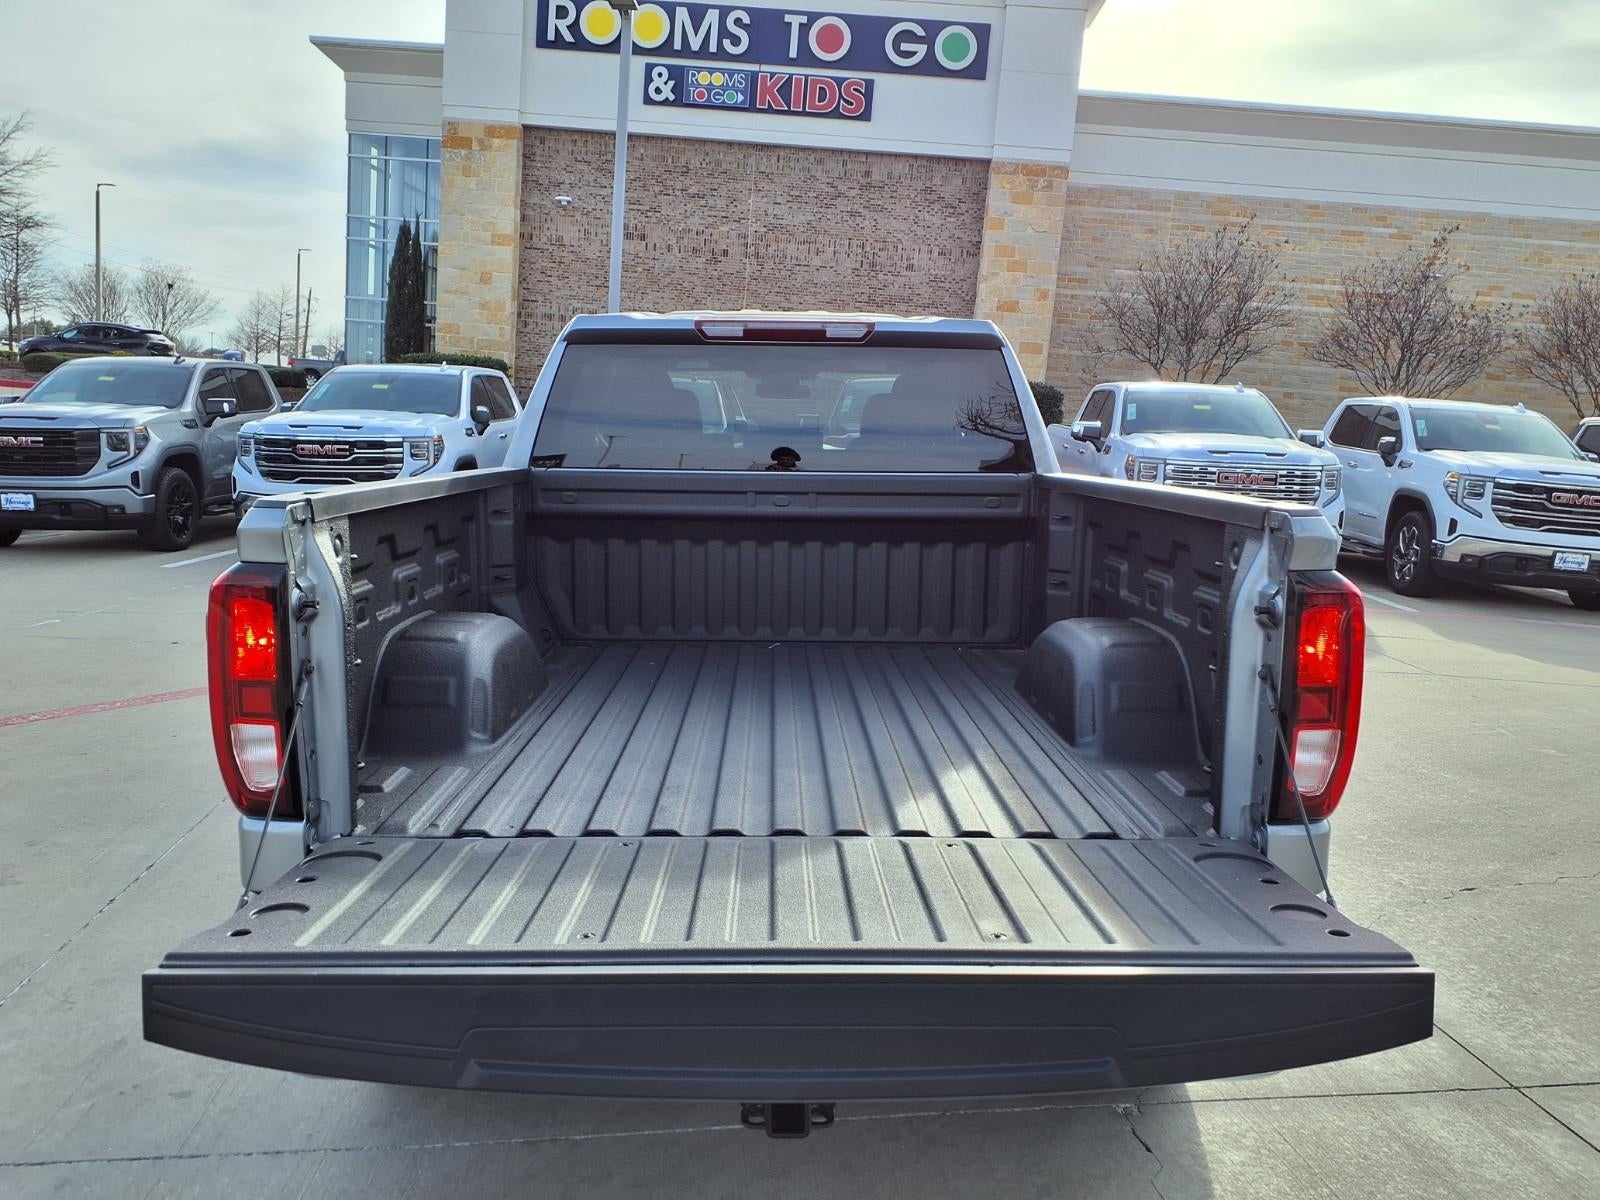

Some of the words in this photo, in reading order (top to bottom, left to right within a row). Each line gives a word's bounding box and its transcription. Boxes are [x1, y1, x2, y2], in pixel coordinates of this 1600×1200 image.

[547, 0, 750, 55] ROOMS
[784, 14, 852, 62] TO
[885, 21, 978, 70] GO
[648, 65, 676, 102] &
[688, 70, 746, 88] ROOMS
[688, 87, 708, 102] TO
[710, 89, 737, 104] GO
[756, 73, 866, 117] KIDS
[296, 444, 350, 456] GMC
[1219, 472, 1278, 486] GMC
